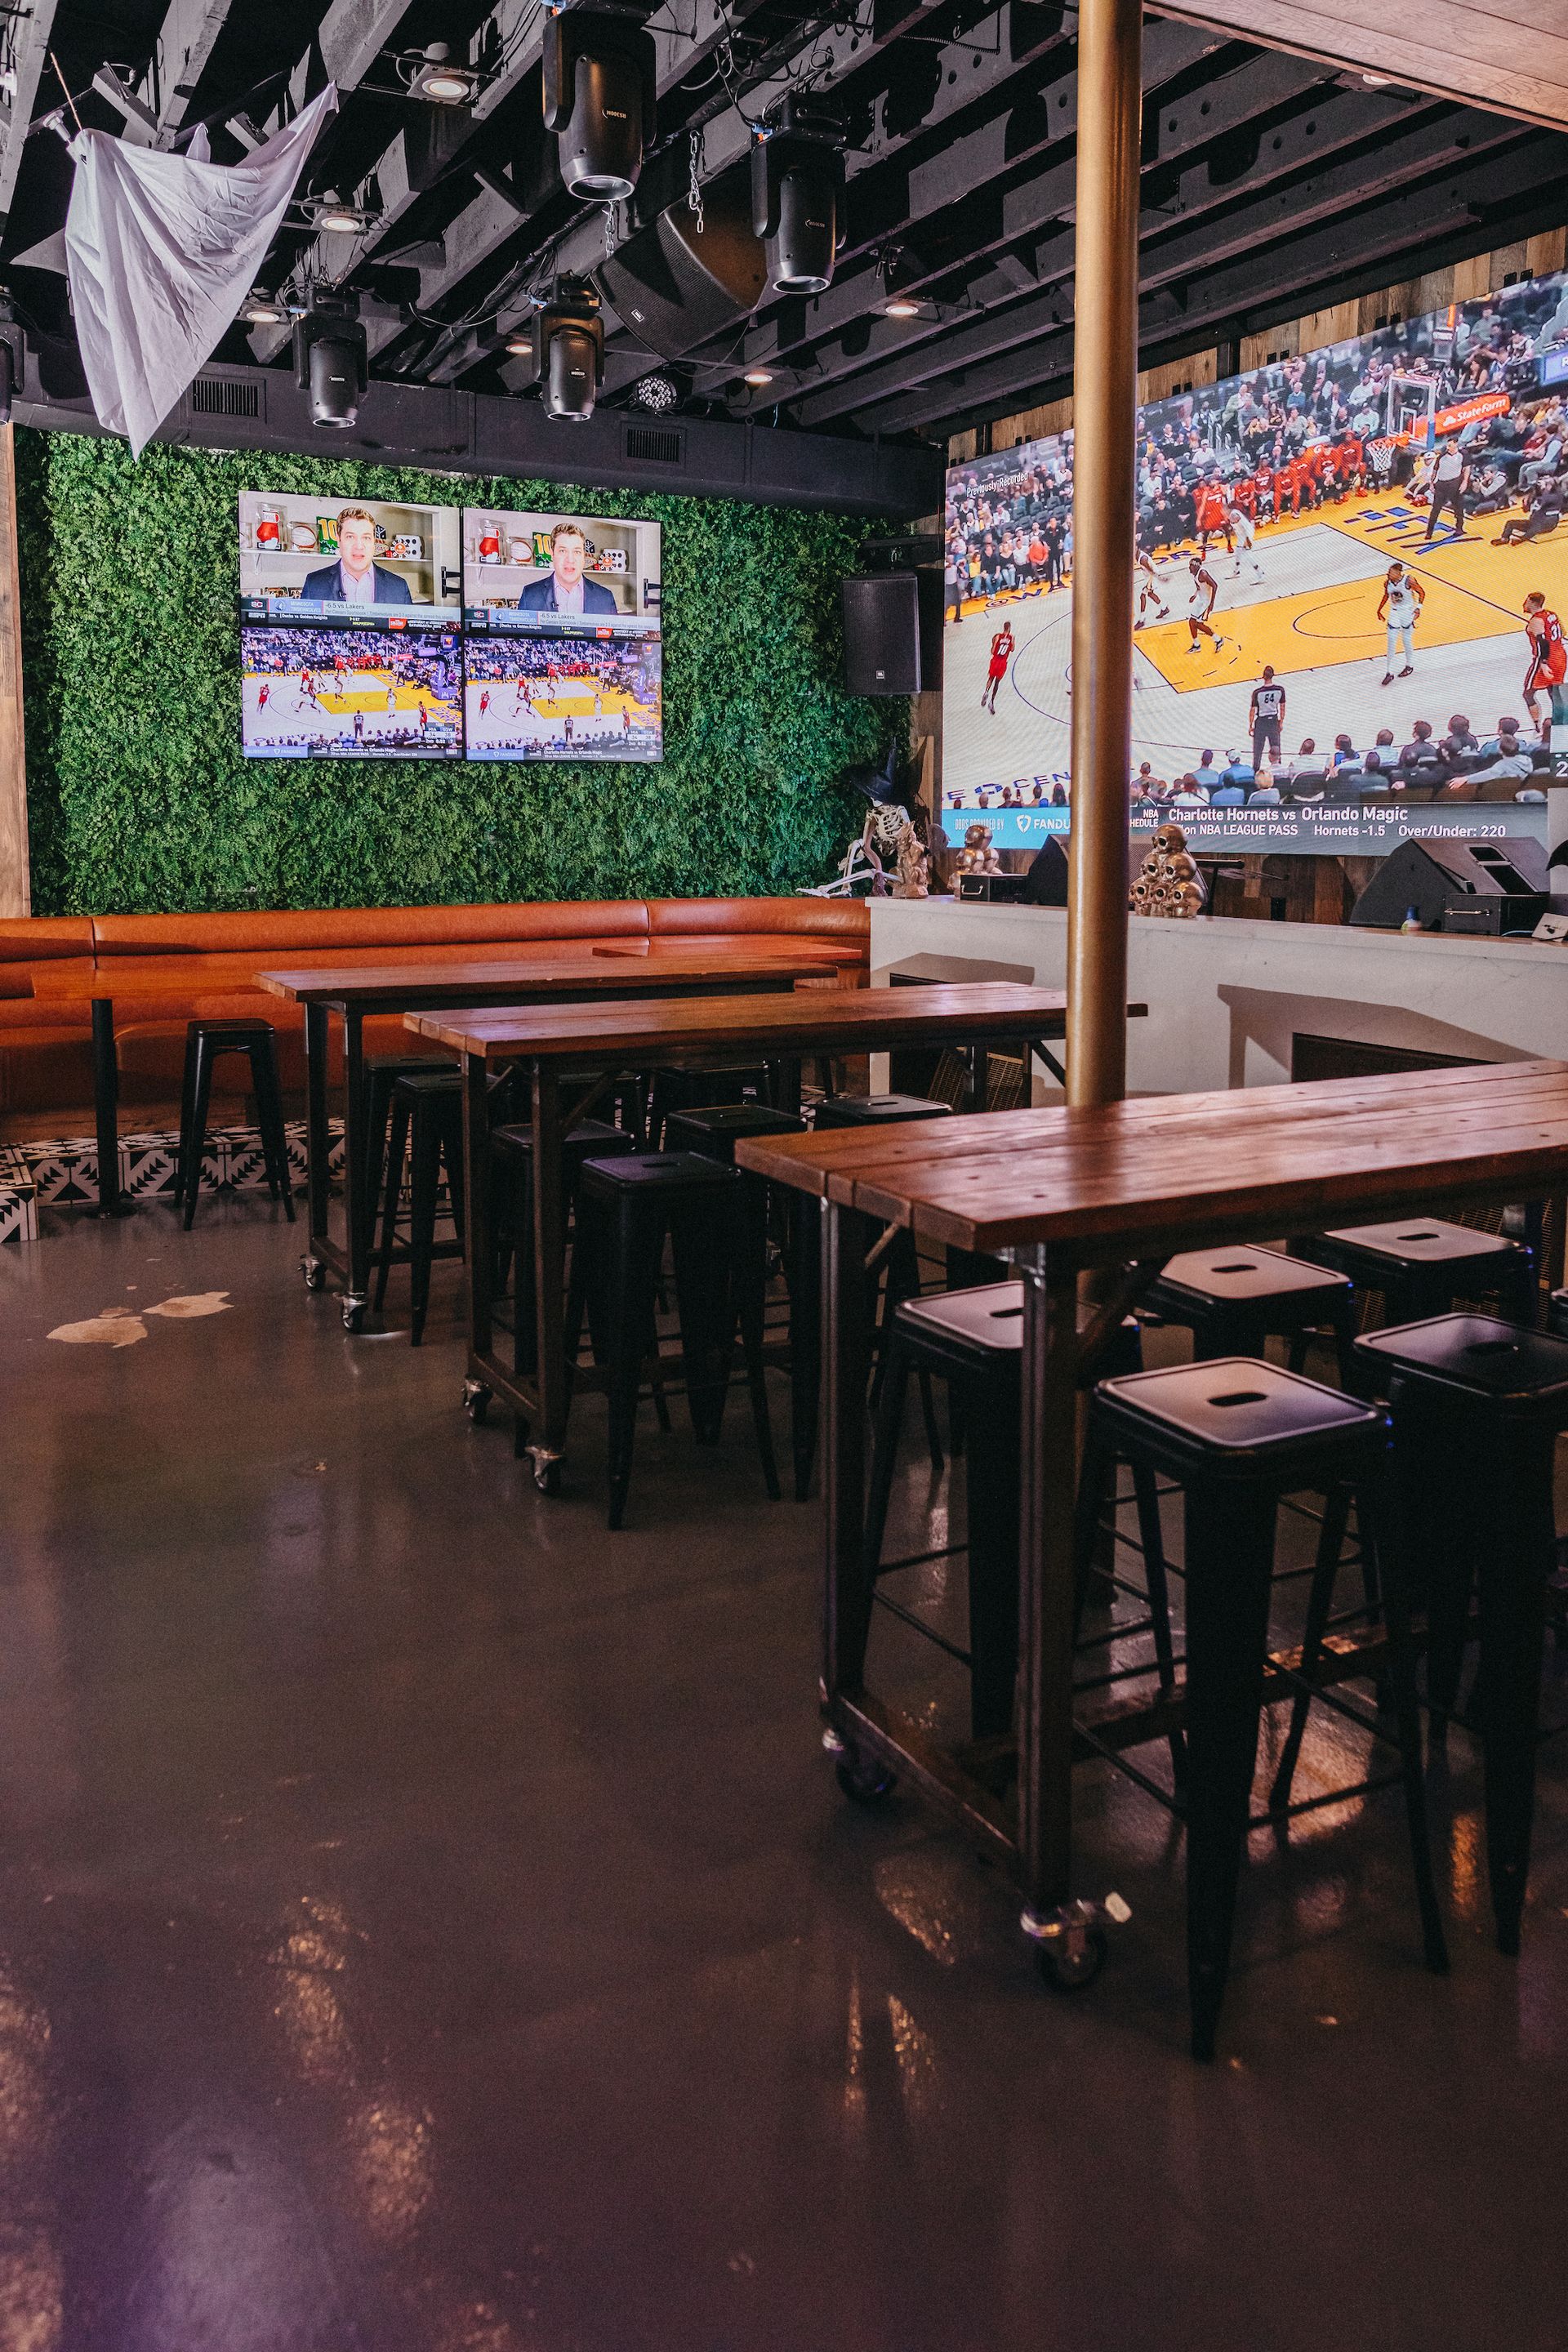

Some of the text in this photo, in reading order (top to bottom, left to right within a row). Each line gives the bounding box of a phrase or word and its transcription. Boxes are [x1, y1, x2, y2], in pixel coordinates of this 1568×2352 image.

[966, 471, 1028, 497] Previously Recorded
[1143, 809, 1159, 818] NBA
[1168, 807, 1408, 823] Charlotte Hornets vs Orlando Magic
[997, 818, 1004, 831] BY
[1033, 818, 1071, 830] FANDU
[1129, 818, 1159, 828] HEDULE
[1186, 826, 1196, 835] on
[1200, 824, 1222, 835] NBA
[1223, 824, 1267, 835] LEAGUE
[1268, 825, 1298, 835] PASS
[1314, 825, 1507, 837] Hornets -1.5 Over/Under: 220
